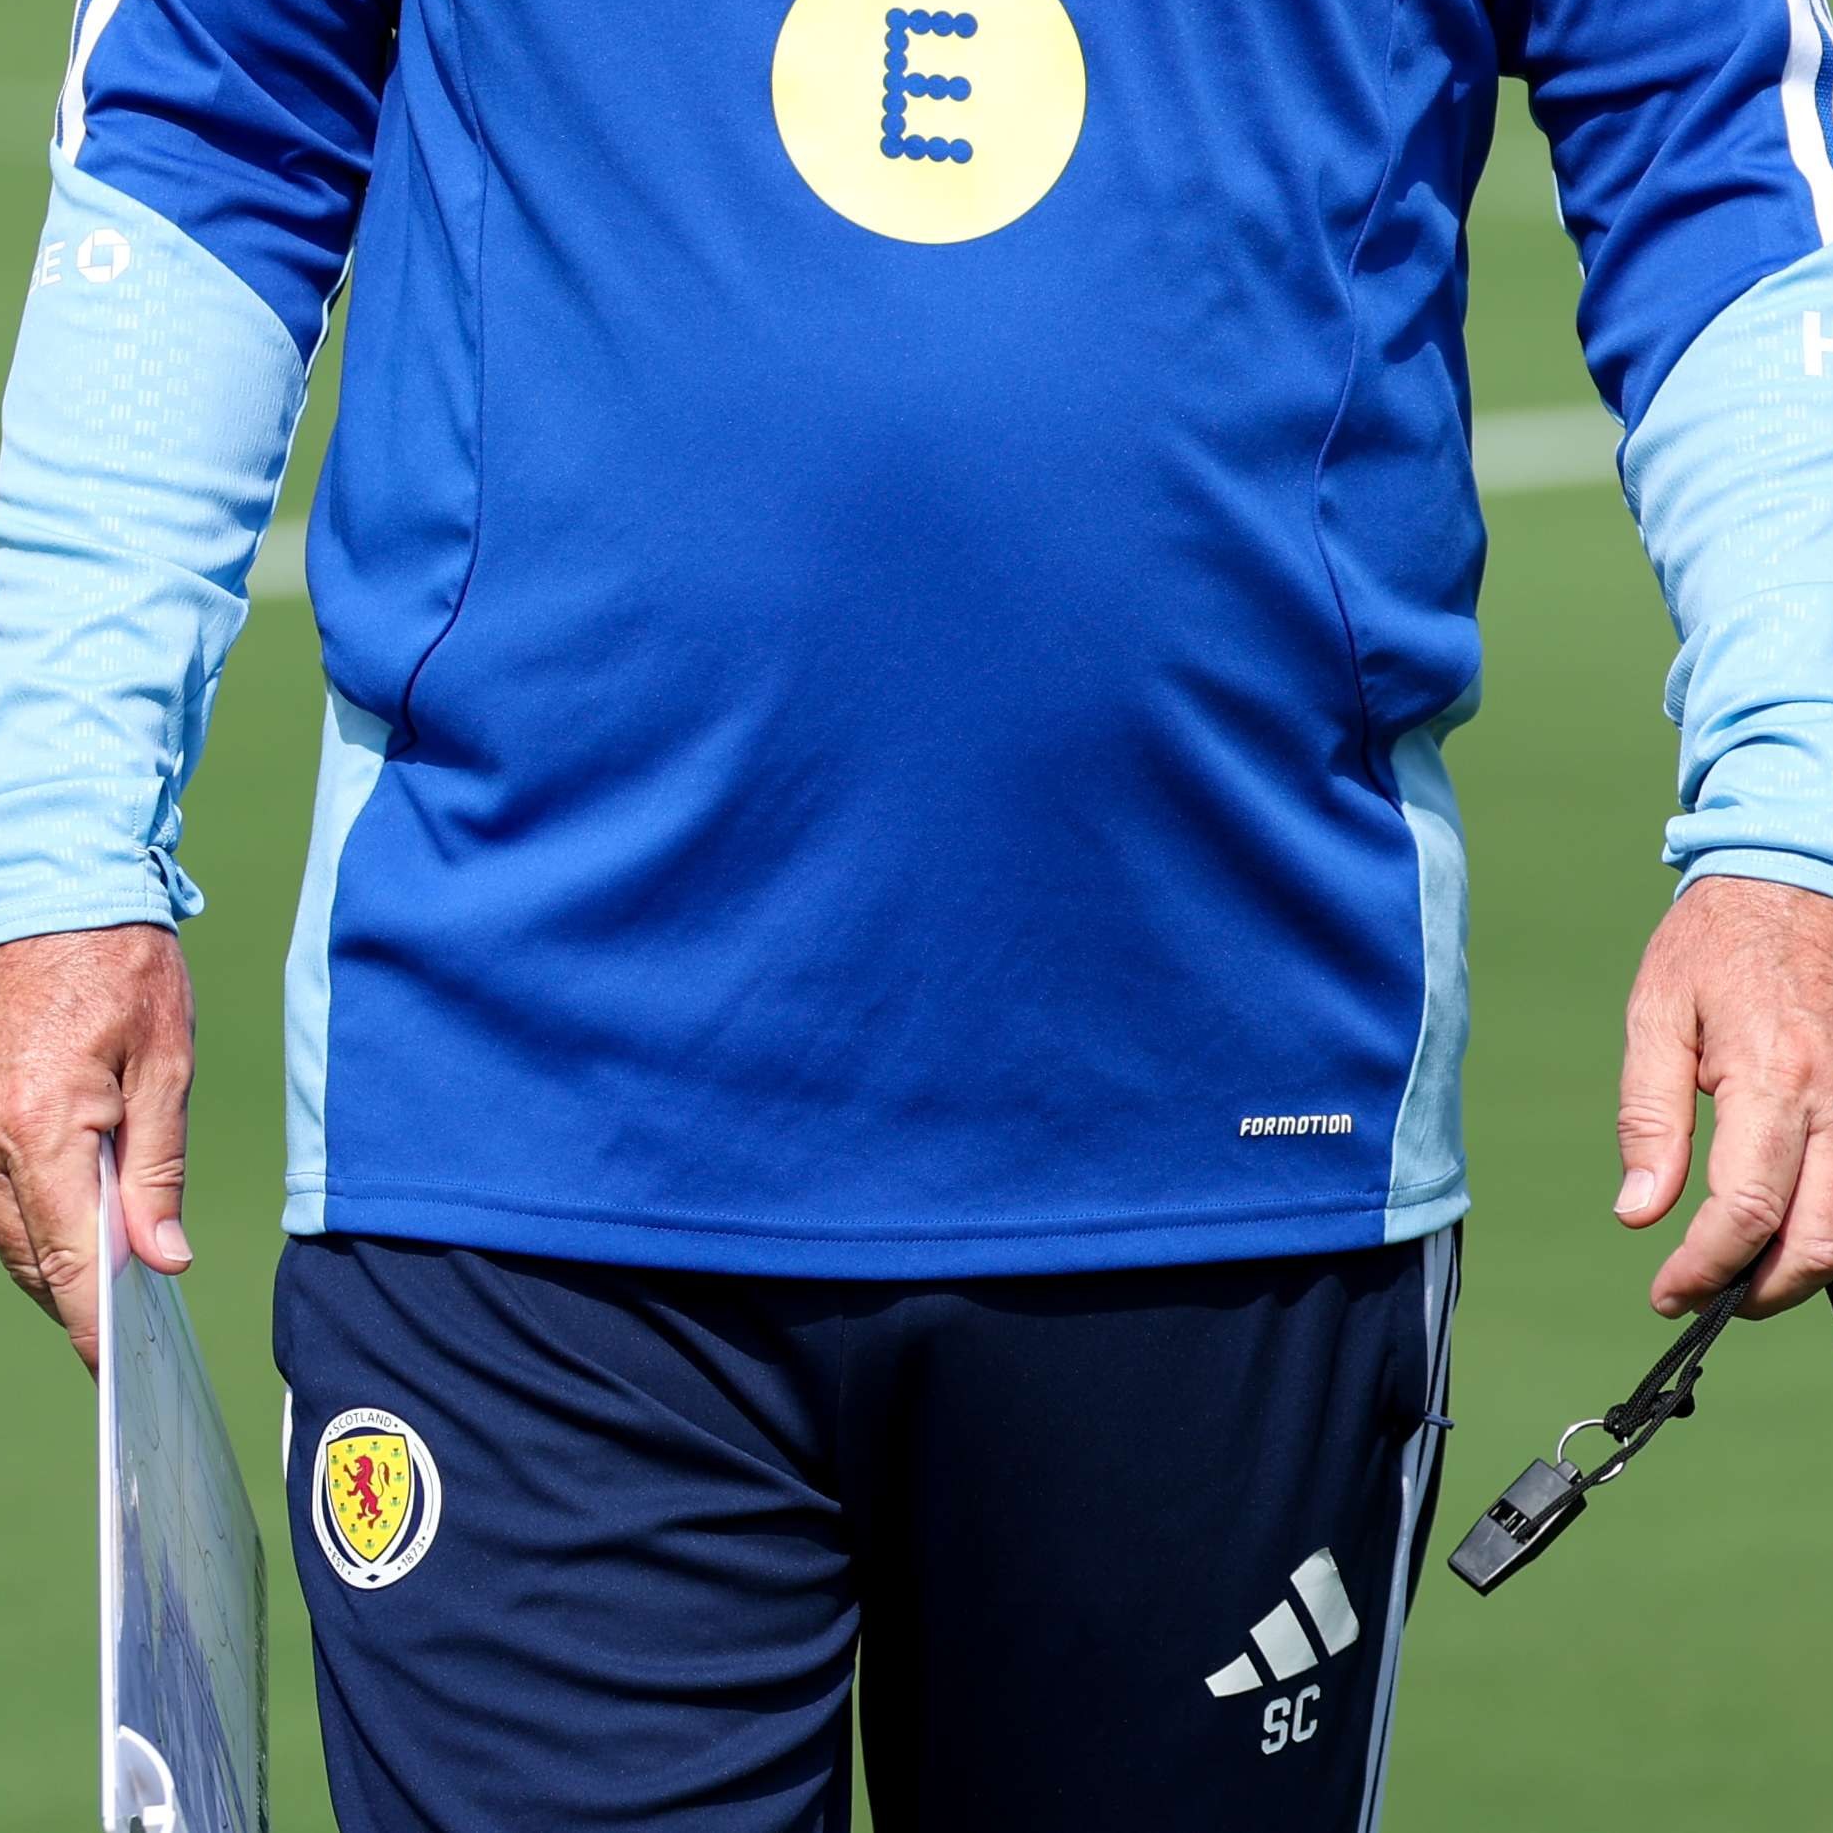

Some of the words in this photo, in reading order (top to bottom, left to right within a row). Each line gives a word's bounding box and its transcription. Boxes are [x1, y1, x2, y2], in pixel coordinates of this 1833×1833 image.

[1239, 1114, 1352, 1137] FORMOTION
[332, 1411, 392, 1434] SCOTLAND
[330, 1550, 347, 1573] EST
[400, 1541, 425, 1567] 1873
[1261, 1684, 1321, 1755] SC
